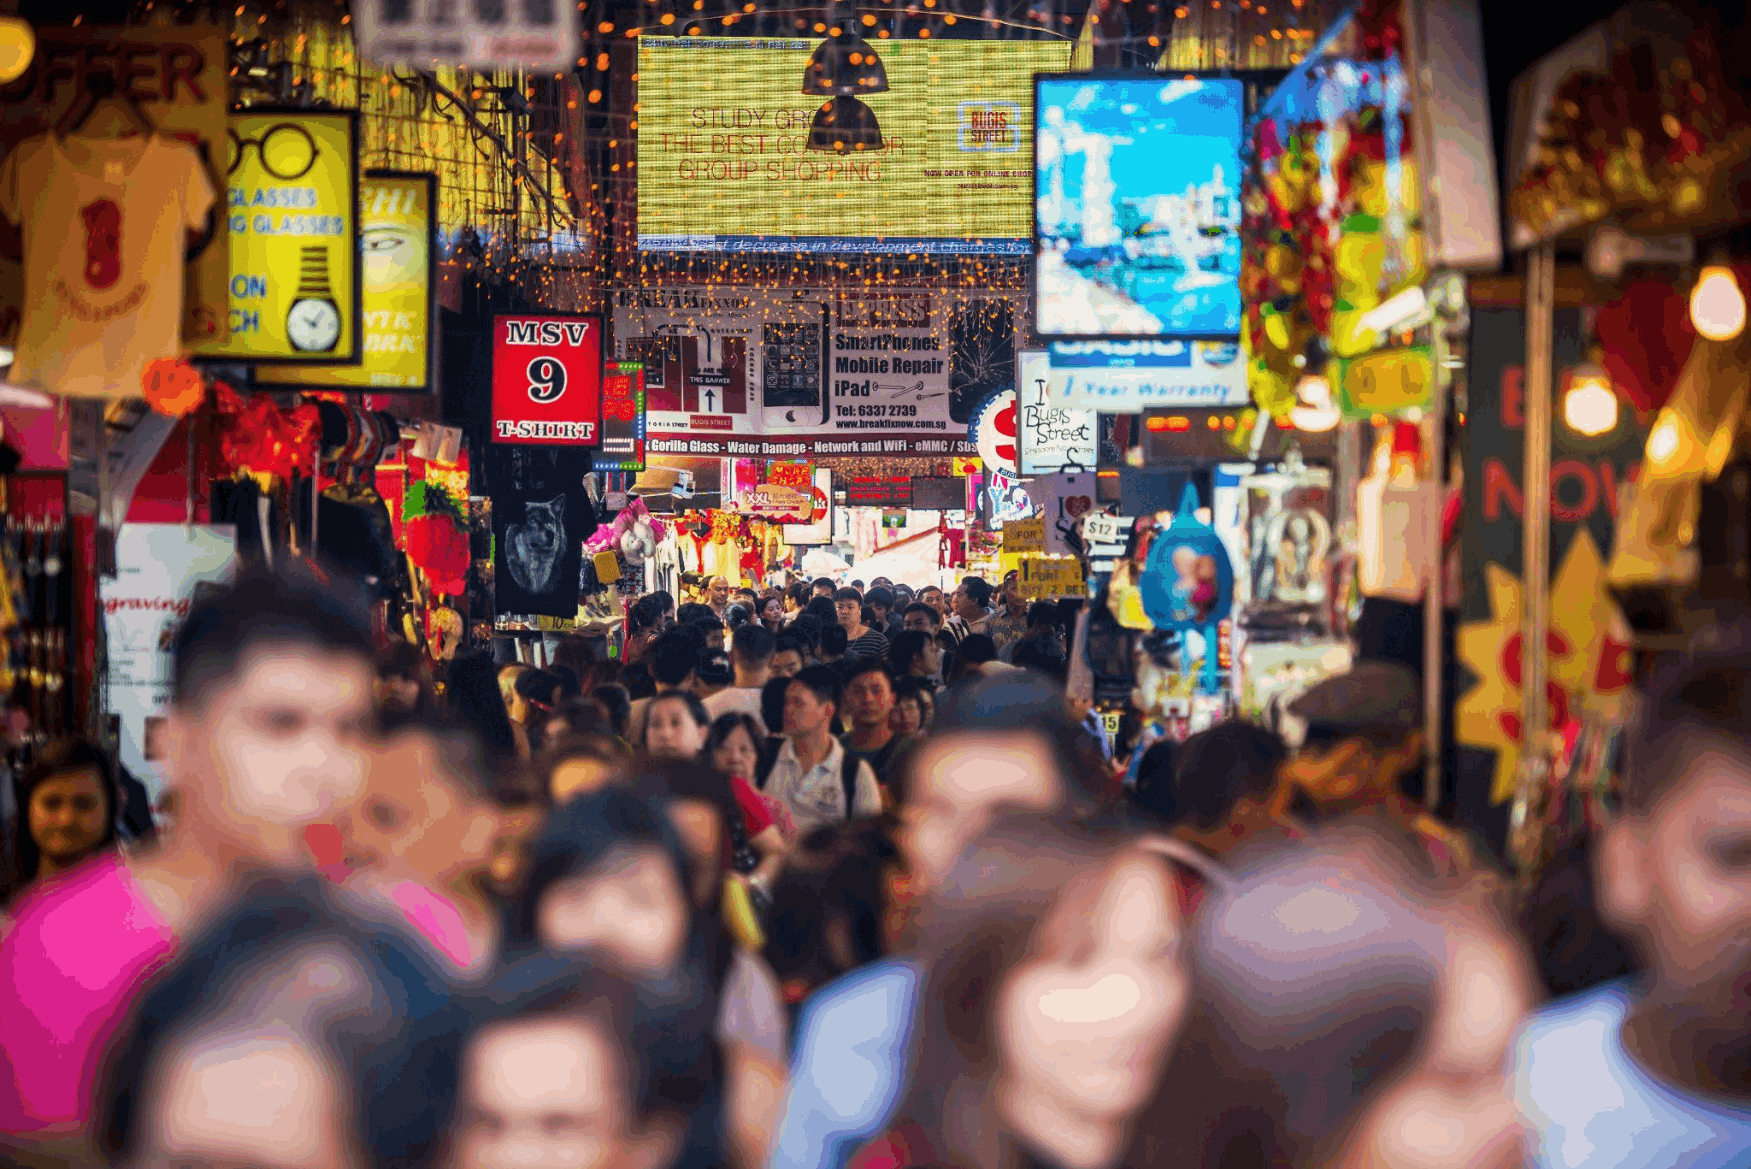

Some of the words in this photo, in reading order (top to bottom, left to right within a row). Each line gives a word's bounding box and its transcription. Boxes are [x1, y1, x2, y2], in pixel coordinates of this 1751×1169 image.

[692, 108, 766, 129] STUDY
[971, 111, 1007, 129] BUGIS
[659, 133, 703, 153] THE
[711, 134, 769, 155] BEST
[971, 130, 1006, 142] STREET
[678, 158, 758, 181] GROUP
[766, 160, 882, 182] SHOPPING
[944, 169, 964, 177] OPEN
[983, 170, 1010, 178] ONLINE
[253, 215, 345, 236] GLASSES
[732, 236, 808, 251] decrease
[812, 238, 828, 250] in
[831, 239, 936, 253] development
[230, 274, 267, 299] ON
[506, 320, 588, 347] MSV
[835, 333, 941, 351] SmartPhones
[835, 357, 890, 374] Mobile
[892, 357, 944, 376] Repair
[525, 356, 568, 404] 9
[689, 376, 703, 384] THIS
[705, 376, 731, 384] BANNER
[834, 380, 870, 397] iPad
[1034, 378, 1046, 406] I
[1084, 382, 1129, 397] Year
[1137, 382, 1232, 405] Warranty
[836, 404, 856, 417] Tel:
[858, 405, 886, 417] 6337
[889, 405, 917, 417] 2739
[1023, 405, 1071, 428] Bugis
[497, 419, 594, 439] T-SHIRT
[690, 418, 709, 426] BUGIS
[709, 419, 732, 427] STREET
[836, 420, 947, 430] www.breakfixnow.com.sg
[1037, 421, 1090, 446] Street
[651, 439, 688, 452] Gorilla
[689, 440, 720, 453] Glass
[727, 441, 760, 454] Water
[762, 442, 807, 455] Damage
[814, 441, 857, 453] Network
[860, 440, 882, 453] and
[883, 440, 907, 453] WiFi
[915, 440, 948, 452] eMMC
[745, 491, 771, 505] XXL
